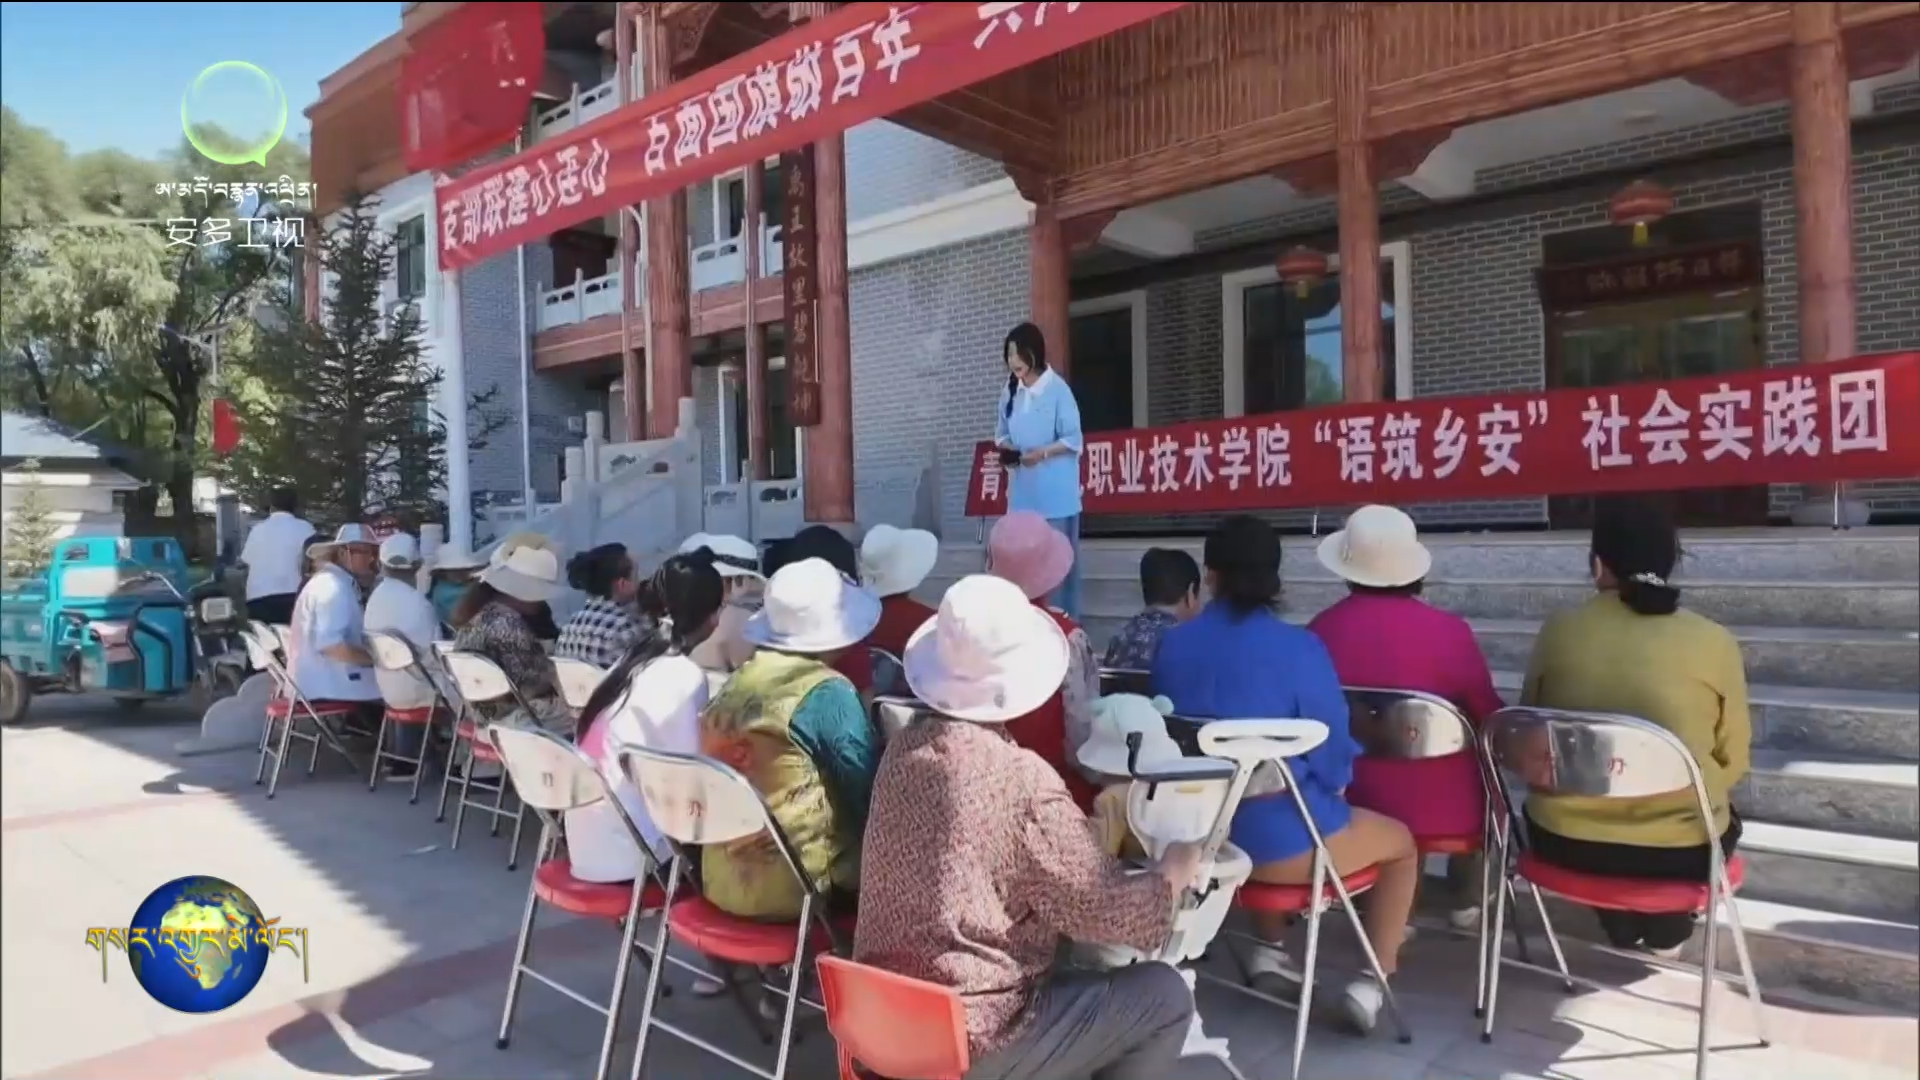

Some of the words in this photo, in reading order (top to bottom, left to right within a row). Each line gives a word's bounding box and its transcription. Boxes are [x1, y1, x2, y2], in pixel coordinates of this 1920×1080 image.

[442, 138, 610, 250] 支部联建心连心
[642, 6, 921, 176] 百面国旗敬百年
[979, 422, 1292, 501] 青职业技术学院
[1314, 400, 1548, 484] “语筑乡安”
[1582, 368, 1888, 470] 社会实践团
